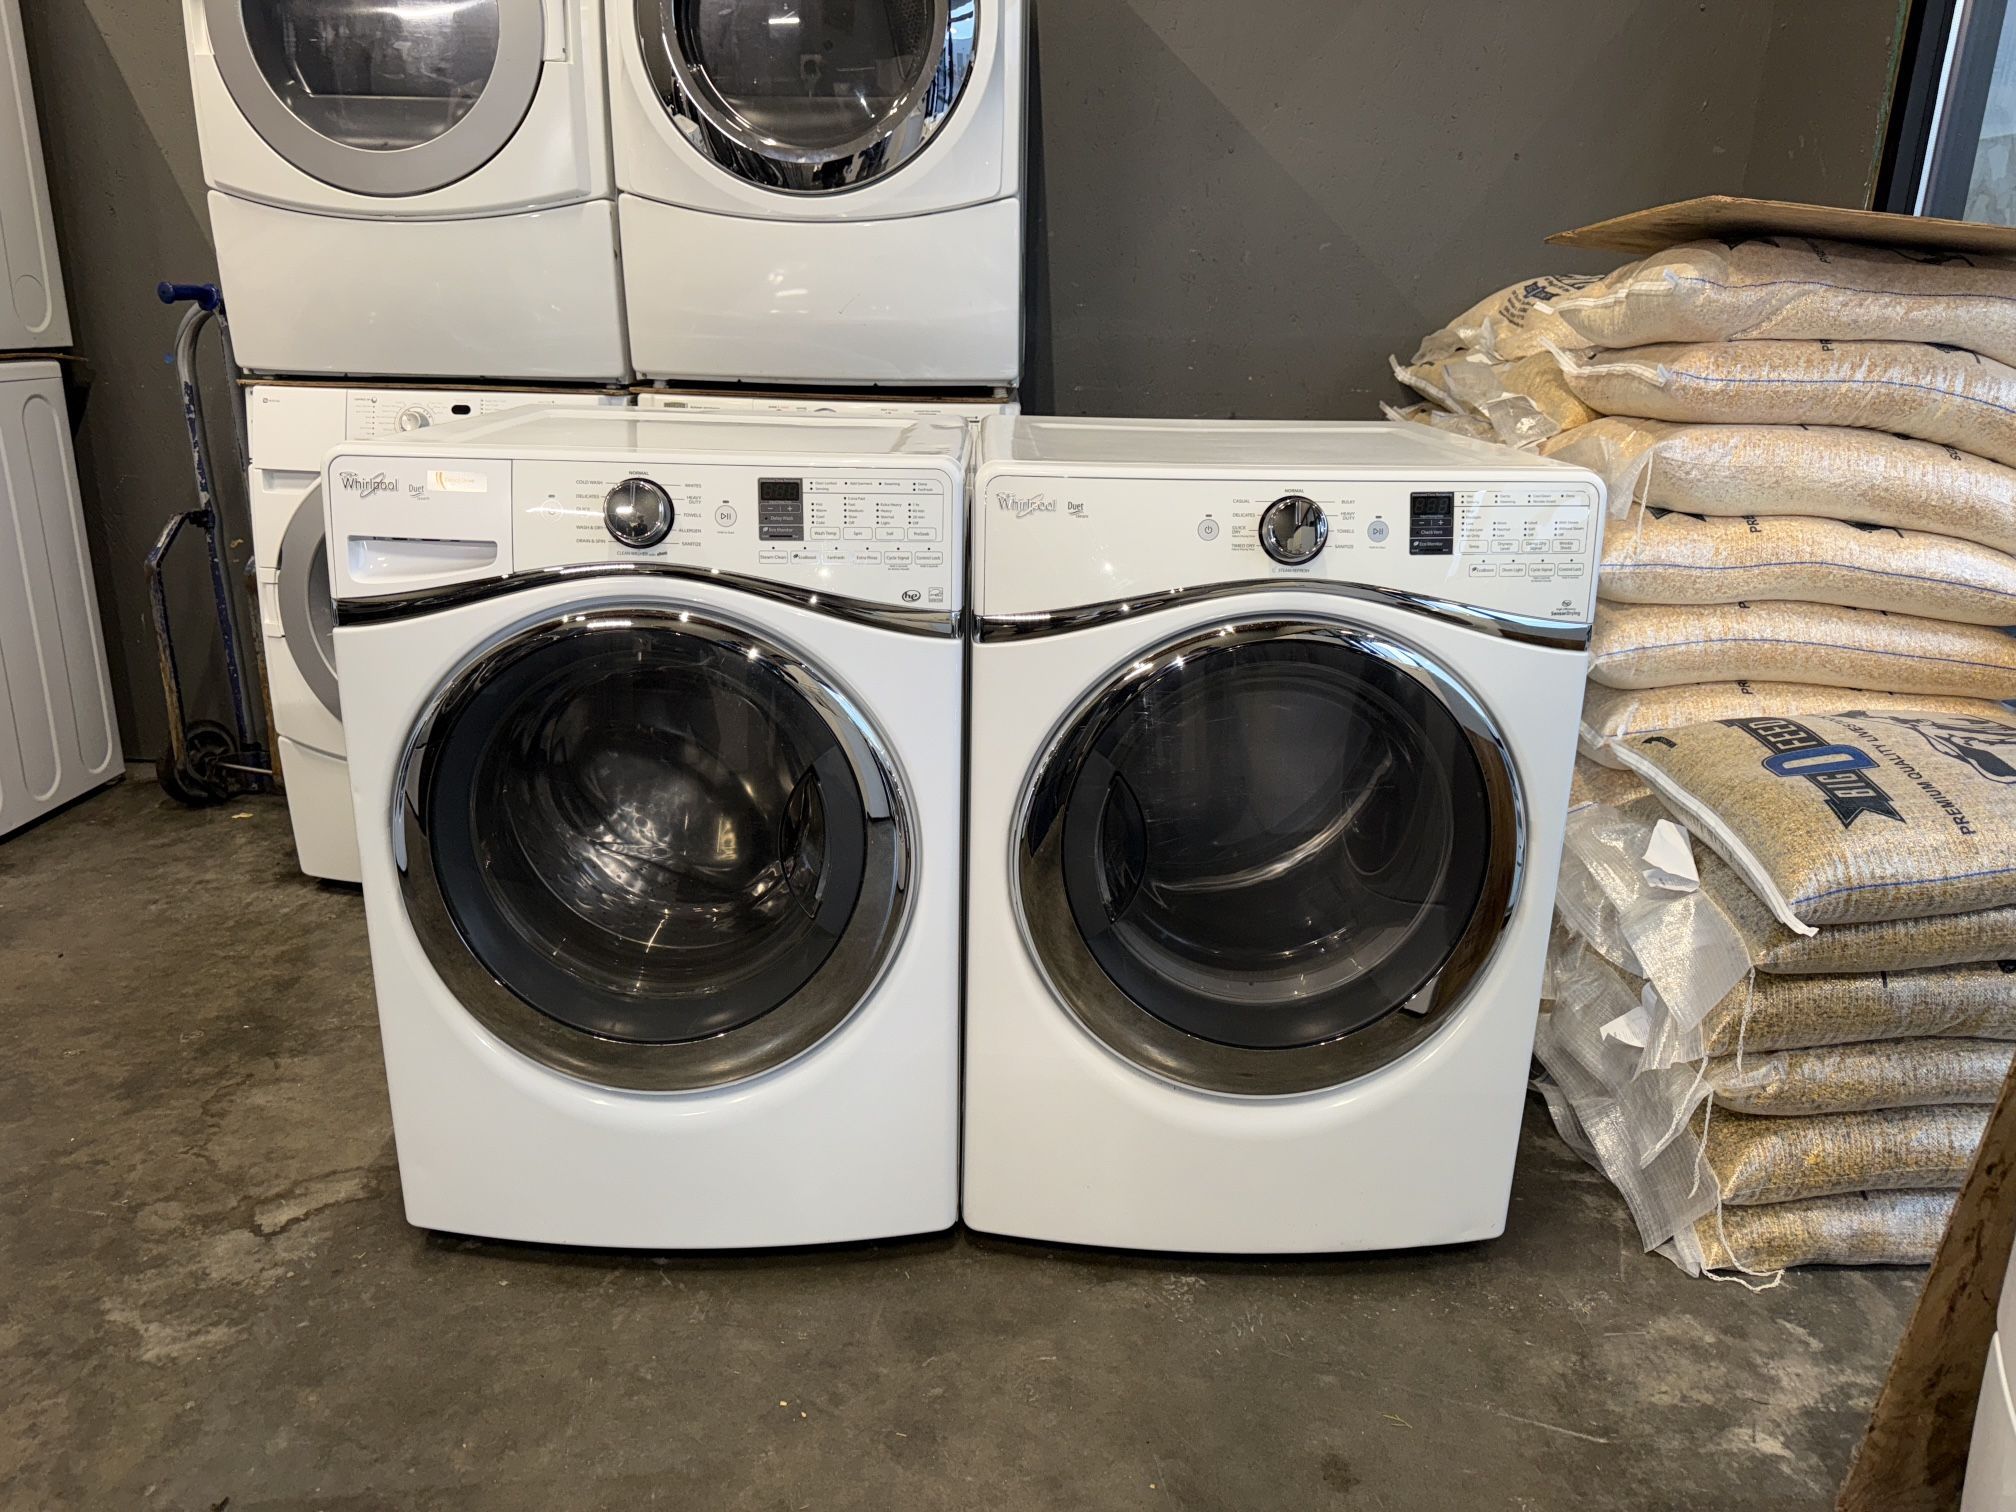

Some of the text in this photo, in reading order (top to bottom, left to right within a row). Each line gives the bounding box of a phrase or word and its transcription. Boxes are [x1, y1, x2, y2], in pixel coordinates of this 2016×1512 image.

[341, 477, 399, 494] Whirlpool
[408, 484, 424, 493] Duet
[998, 496, 1056, 514] Whirlpool
[1067, 501, 1084, 511] Duet
[903, 590, 920, 601] he
[1748, 719, 1818, 750] FEED
[1872, 743, 1922, 780] QUALITY
[1816, 773, 1877, 798] BIG
[1916, 781, 1977, 836] PREMIUM
